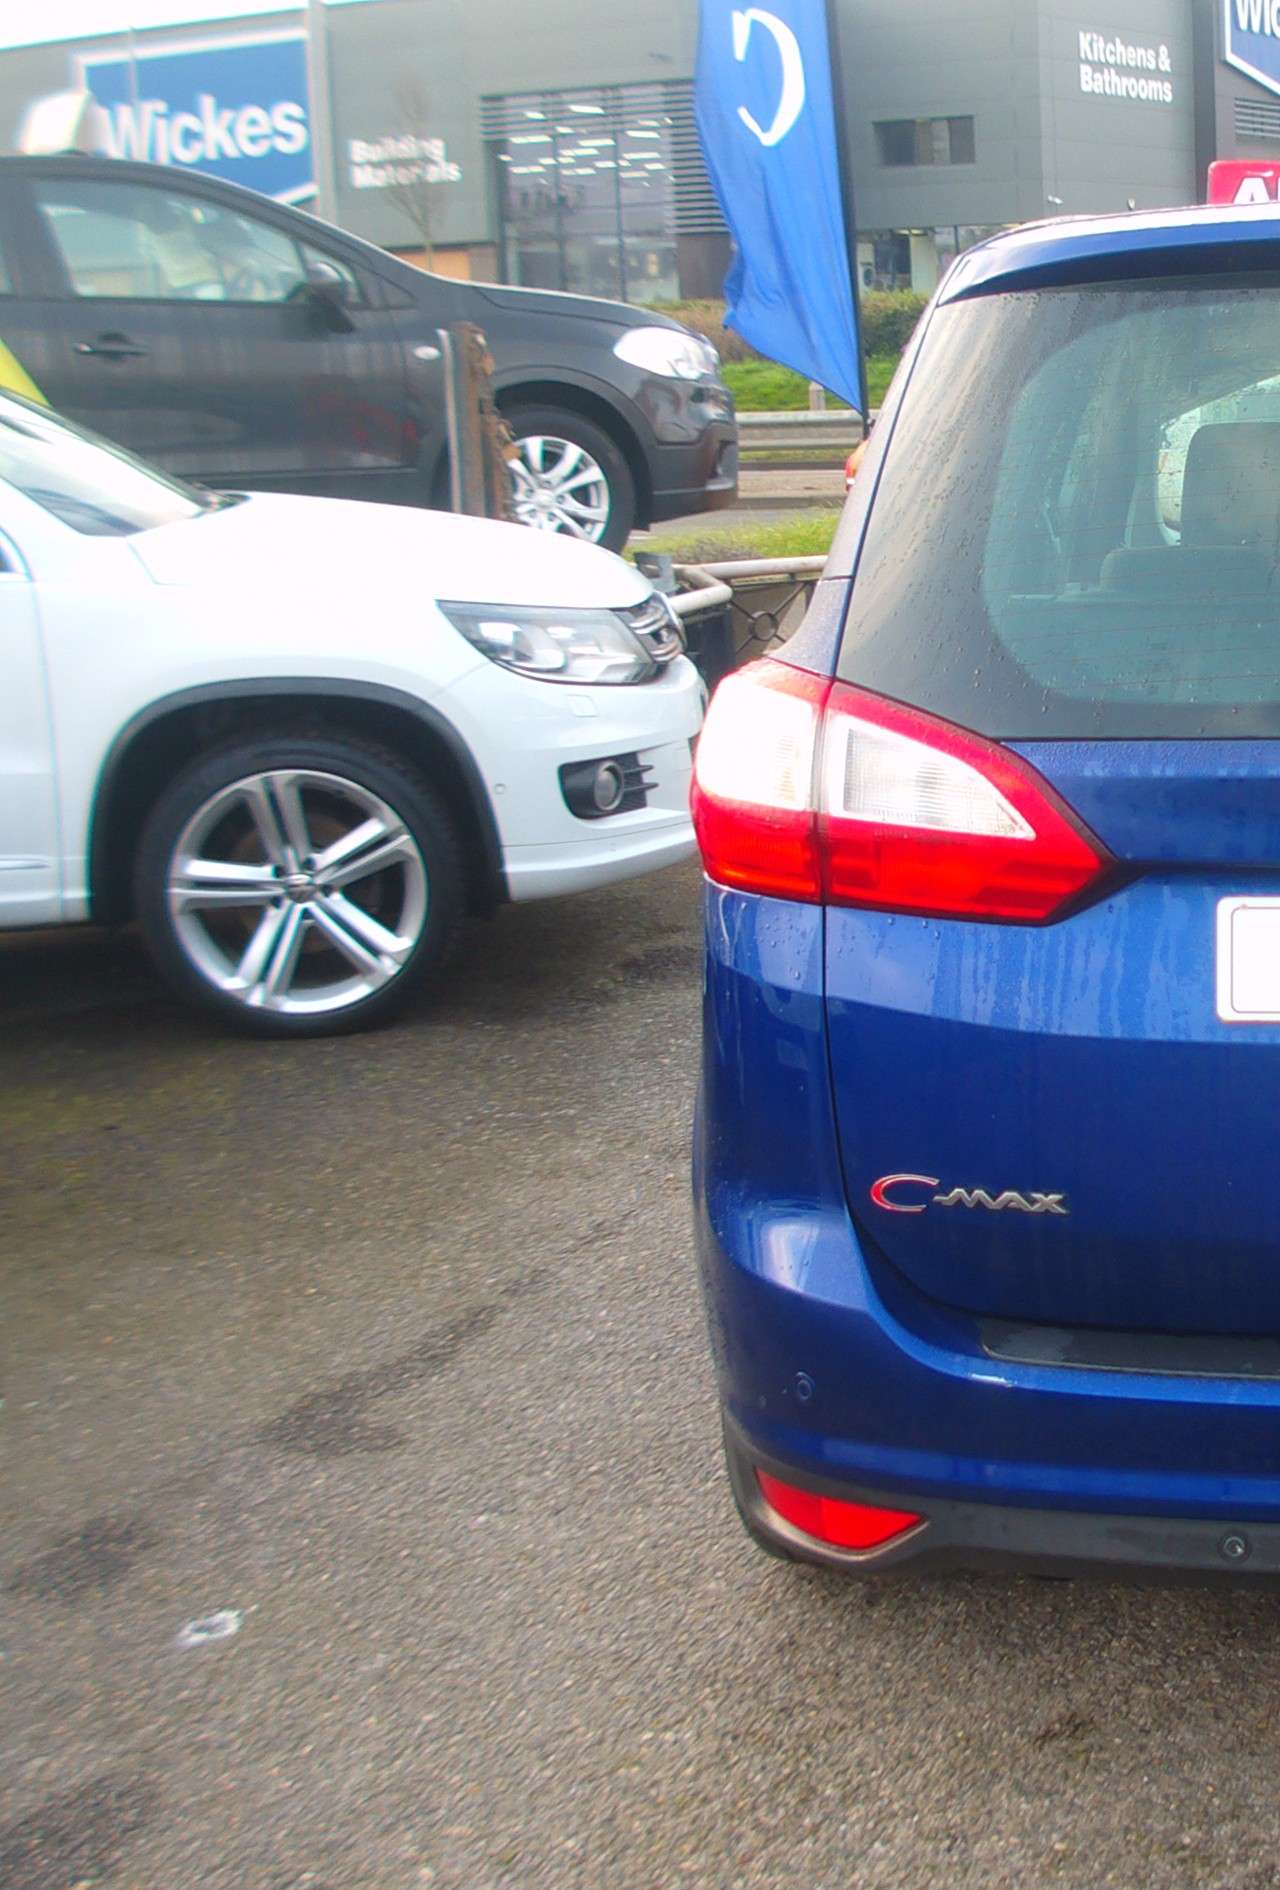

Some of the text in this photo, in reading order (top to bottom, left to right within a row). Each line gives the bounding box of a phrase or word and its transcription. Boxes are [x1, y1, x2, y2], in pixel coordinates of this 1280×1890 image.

[1079, 31, 1172, 72] Kitchens &
[1080, 63, 1173, 103] Bathrooms
[98, 93, 308, 163] Wickes
